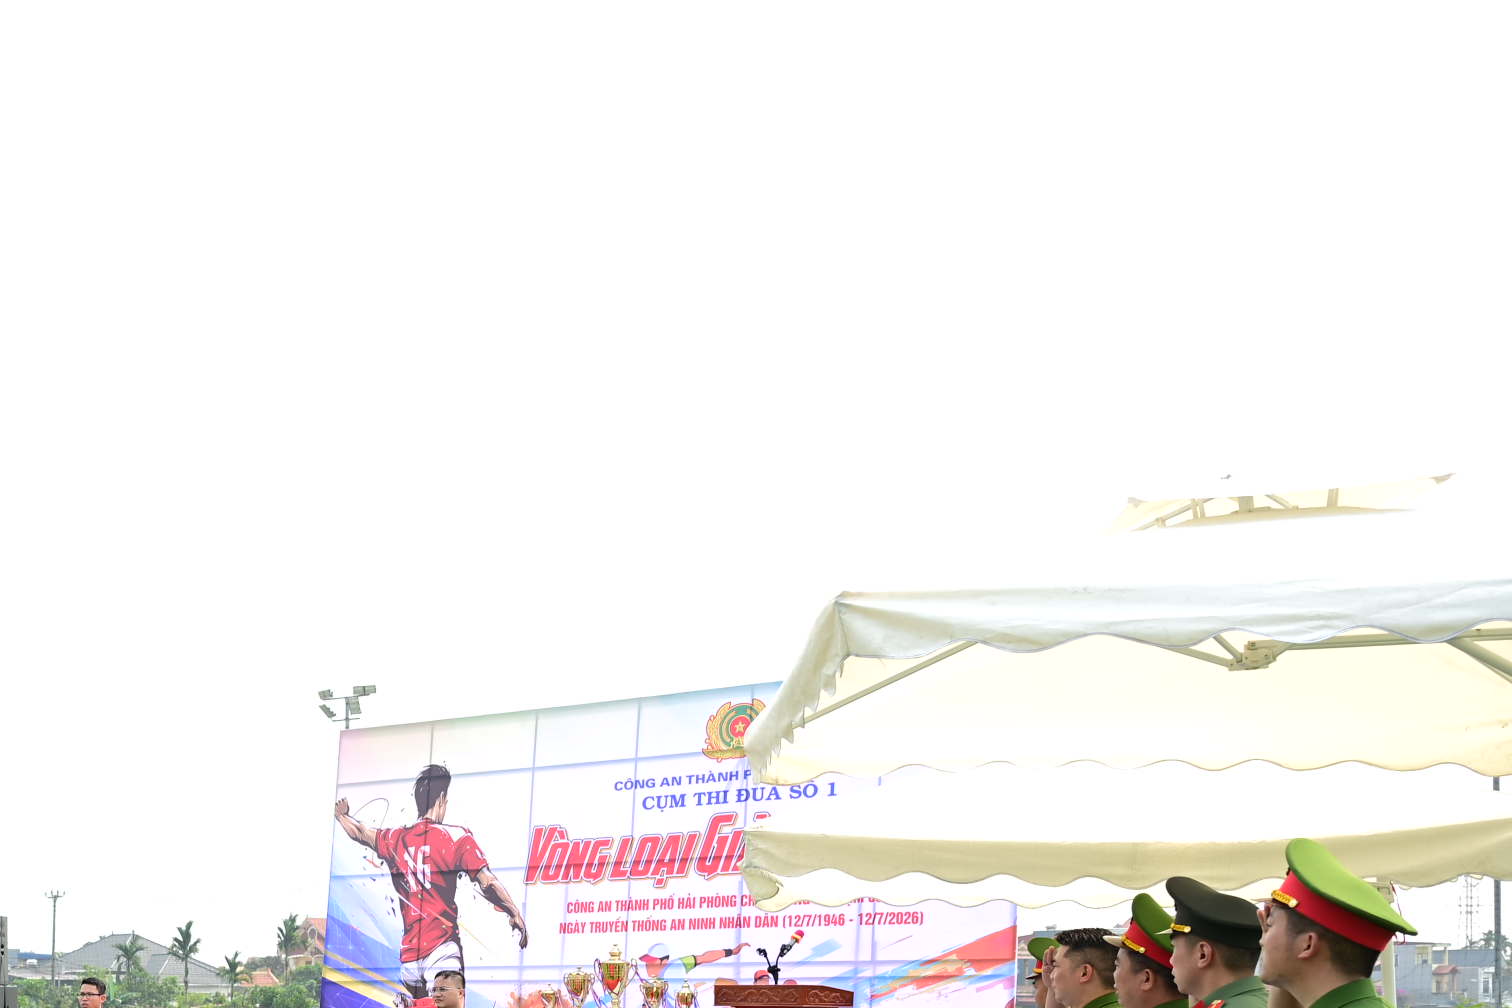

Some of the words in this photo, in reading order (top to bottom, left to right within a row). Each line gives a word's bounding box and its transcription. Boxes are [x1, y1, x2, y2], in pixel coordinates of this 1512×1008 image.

[614, 777, 656, 791] CÔNG
[660, 775, 682, 787] AN
[686, 770, 739, 785] THÀNH
[642, 793, 687, 812] CỤM
[693, 789, 729, 806] THI
[735, 786, 782, 802] ĐUA
[828, 782, 837, 797] 1
[524, 825, 613, 884] VÒNG
[608, 831, 700, 888] LOẠI
[566, 899, 595, 914] CÔNG
[597, 900, 612, 913] AN
[615, 896, 650, 911] THÀNH
[652, 893, 675, 910] PHỐ
[677, 893, 696, 909] HẢI
[699, 892, 737, 908] PHÒNG
[559, 919, 587, 934] NGÀY
[632, 915, 667, 932] THỐNG
[670, 919, 685, 931] AN
[688, 917, 716, 930] NINH
[719, 913, 751, 929] NHÂN
[754, 913, 779, 928] DÂN
[782, 913, 846, 929] (12/7/1946
[857, 911, 924, 927] 12/7/2026)
